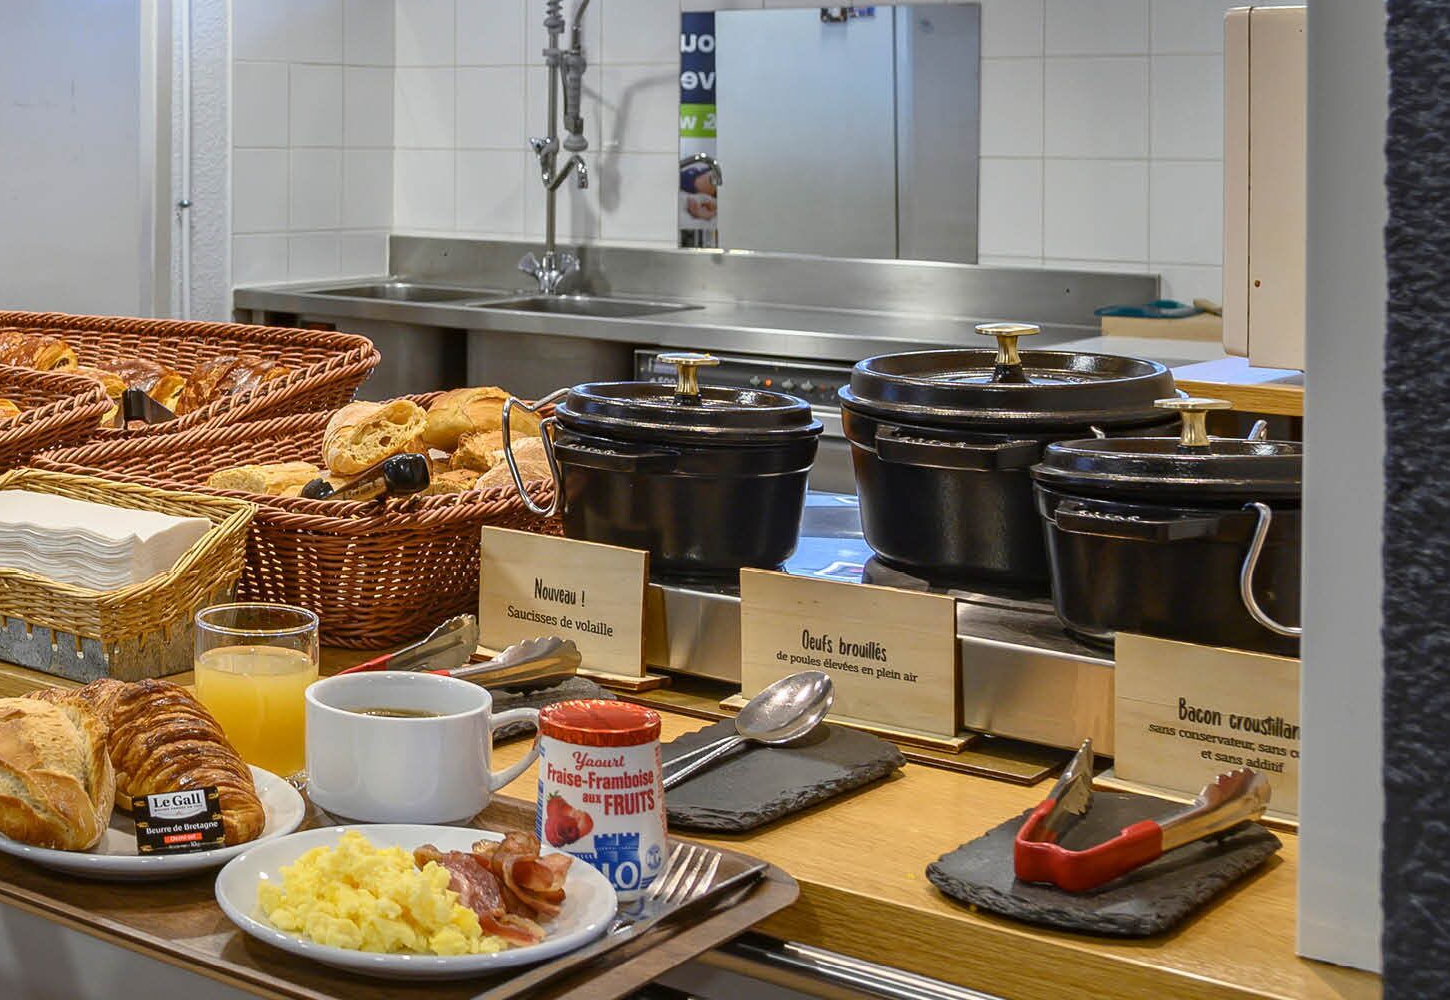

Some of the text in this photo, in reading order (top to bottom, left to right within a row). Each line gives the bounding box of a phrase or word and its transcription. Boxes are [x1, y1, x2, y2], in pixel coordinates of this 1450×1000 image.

[534, 577, 586, 607] Nouveau !
[507, 605, 613, 637] Saucisses de volaille
[802, 629, 887, 662] Oeufs brouillés
[776, 651, 918, 682] de poules élevées en plein air
[1178, 697, 1222, 726] Bacon
[1149, 724, 1176, 736] sans
[1179, 729, 1256, 752] conservateur,
[1258, 743, 1287, 756] sans
[572, 751, 625, 771] Yaourt
[1201, 750, 1284, 773] et sans additif
[547, 763, 654, 790] Fraise-Framboise
[153, 793, 201, 808] Le Gall
[582, 789, 655, 816] aux FRUITS
[146, 821, 219, 834] Beurre de Bretagne
